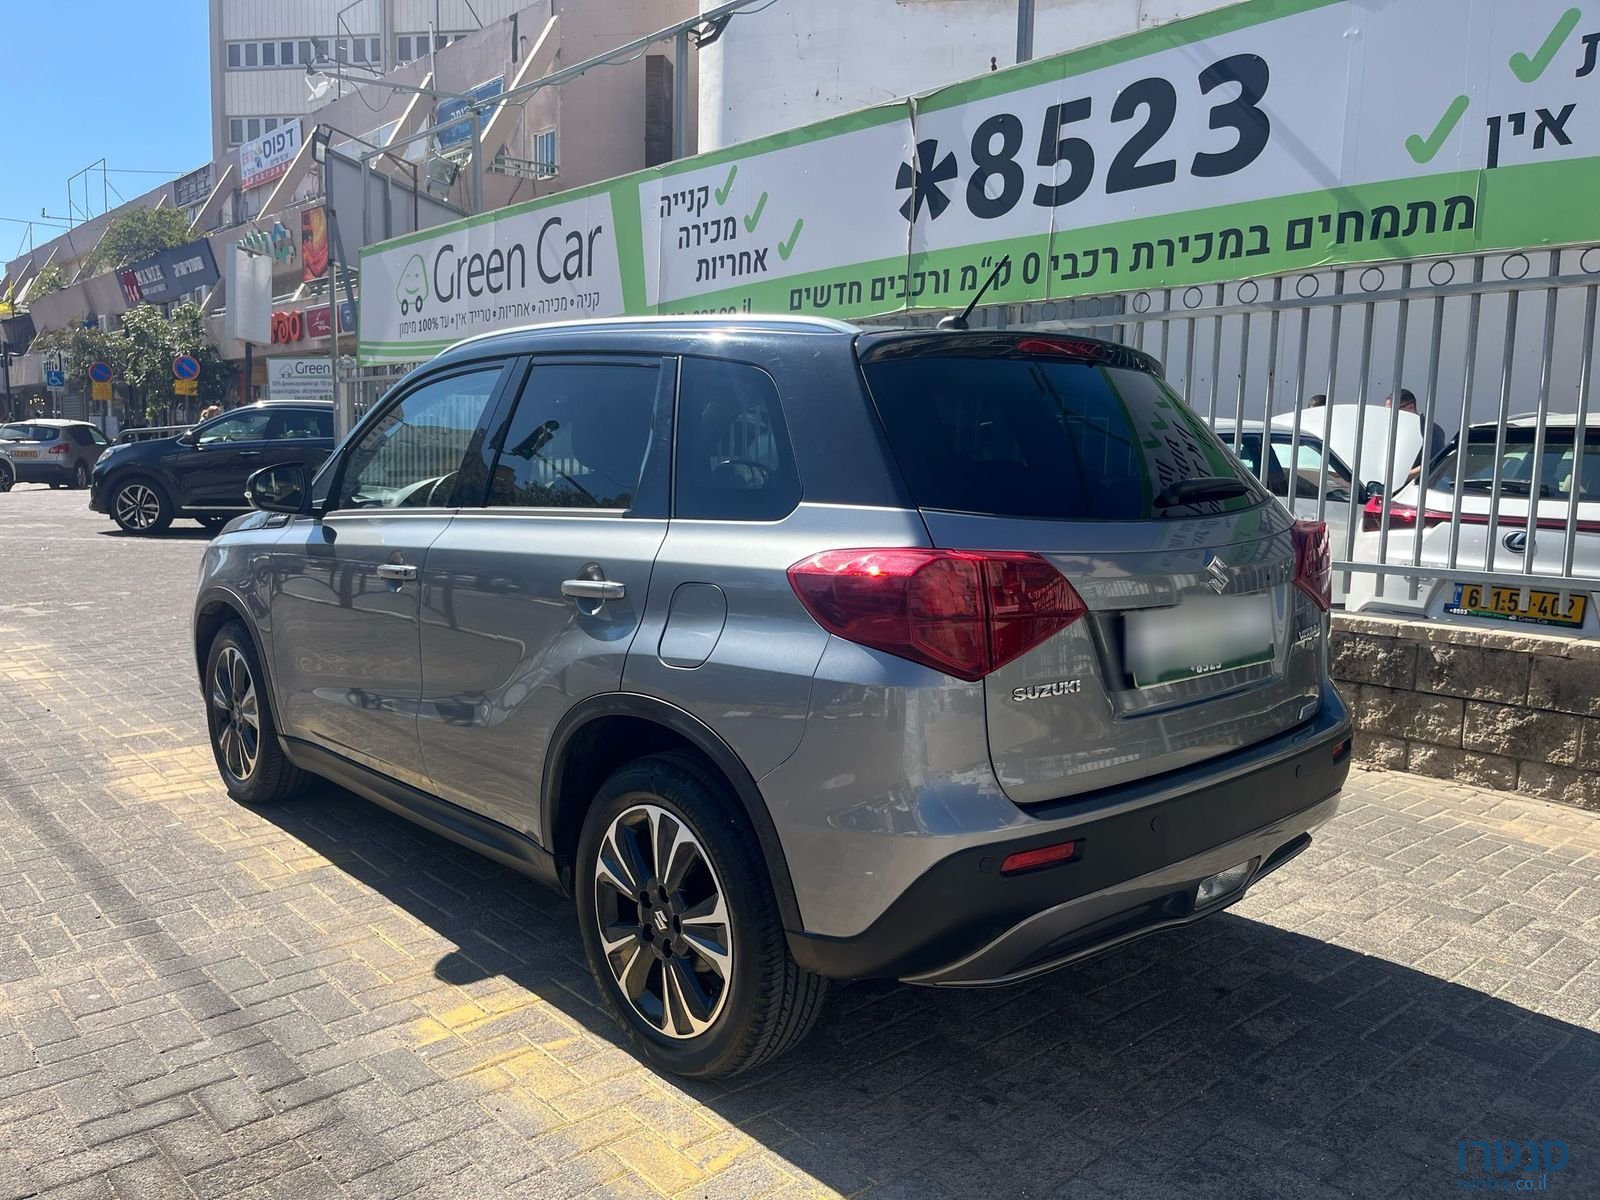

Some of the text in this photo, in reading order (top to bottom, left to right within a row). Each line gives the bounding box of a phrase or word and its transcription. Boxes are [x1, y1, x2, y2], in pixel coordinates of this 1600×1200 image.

[262, 128, 294, 159] דפוס
[1486, 103, 1578, 169] אין
[660, 185, 709, 218] קנייה
[678, 216, 737, 249] מכירה
[1286, 195, 1475, 251] מתמחים
[433, 216, 602, 303] Green Car
[696, 247, 768, 282] אחריות
[1050, 247, 1118, 281] רכבי
[1129, 225, 1270, 272] במכירת
[1022, 251, 1041, 285] 0
[789, 280, 863, 311] חדשים
[870, 269, 950, 302] ורכבים
[399, 292, 600, 338] קניה מכירה אחריות טרייד אין עד 100% מימון
[295, 361, 330, 374] Green
[1012, 679, 1082, 702] SUZUKI
